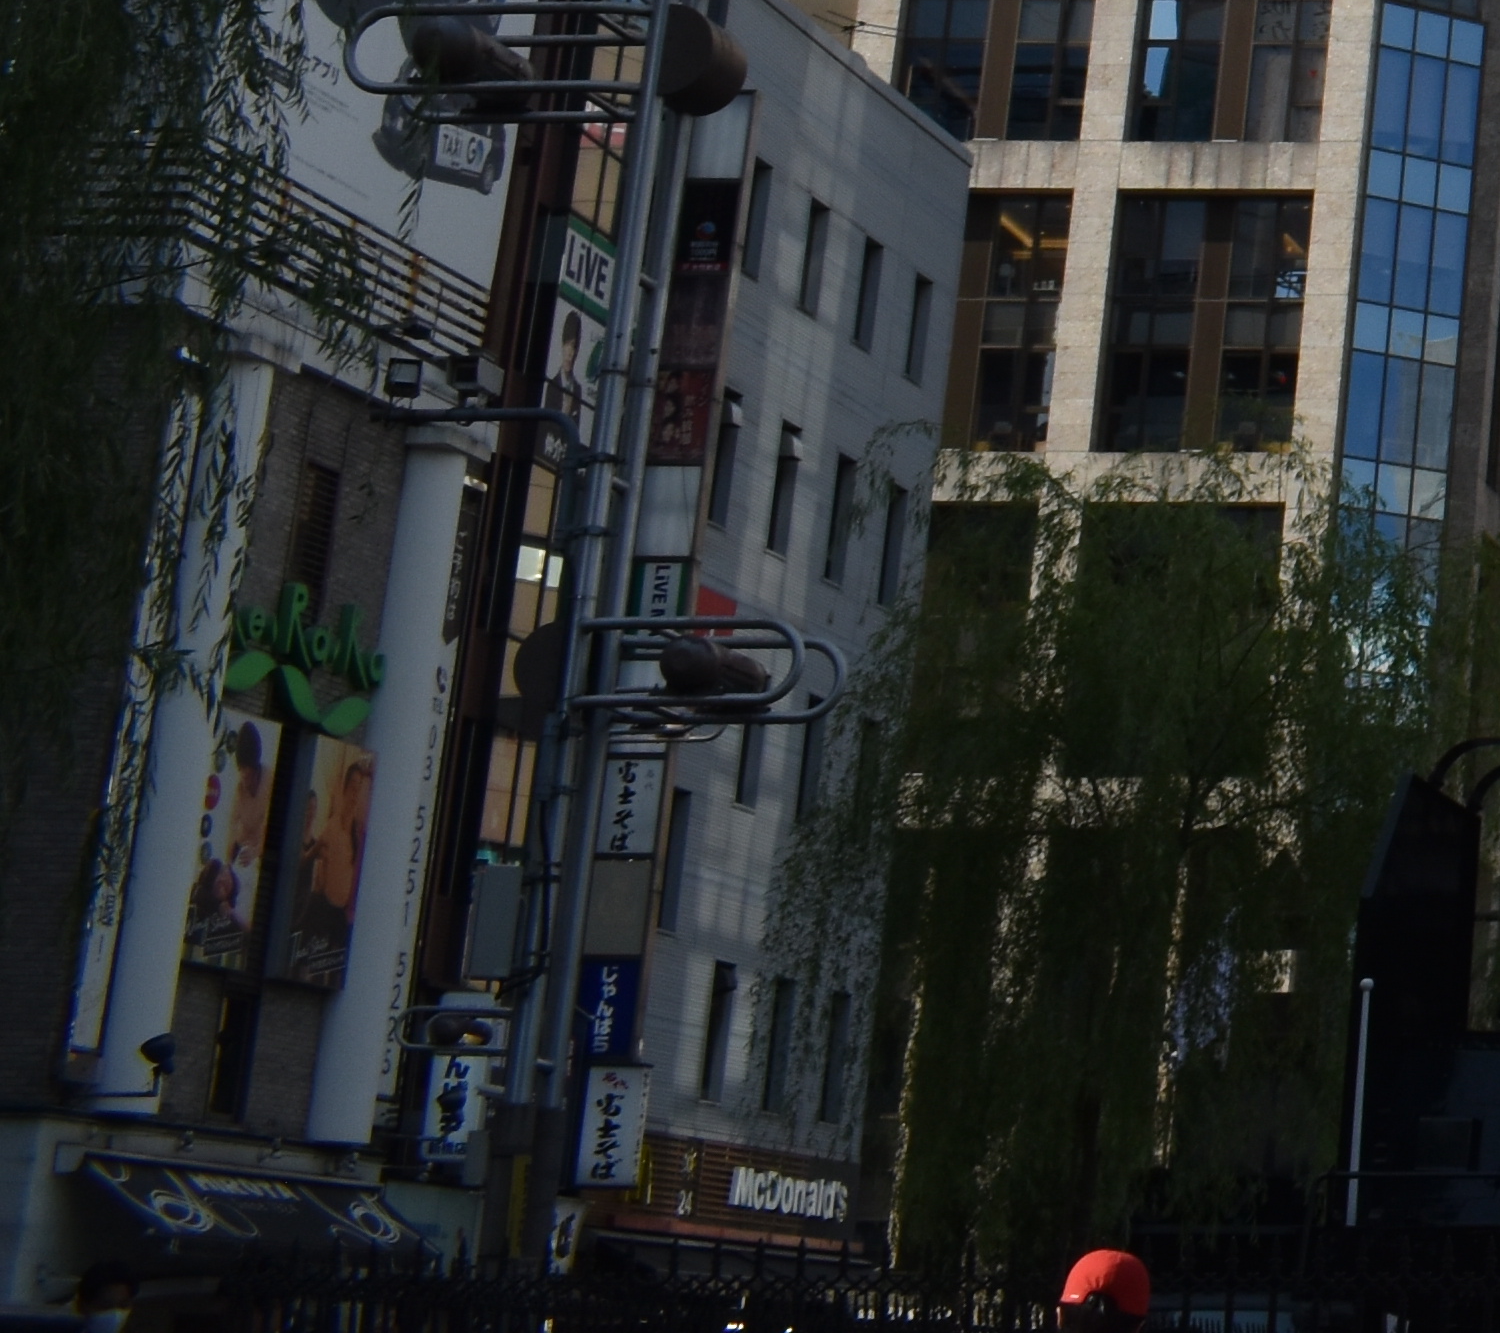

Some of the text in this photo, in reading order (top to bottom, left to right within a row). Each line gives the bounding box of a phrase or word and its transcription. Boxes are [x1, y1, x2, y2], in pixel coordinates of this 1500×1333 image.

[440, 132, 464, 158] TAXI
[609, 761, 638, 852] 富士そば
[676, 1188, 693, 1217] 24
[728, 1165, 849, 1224] McDonald's
